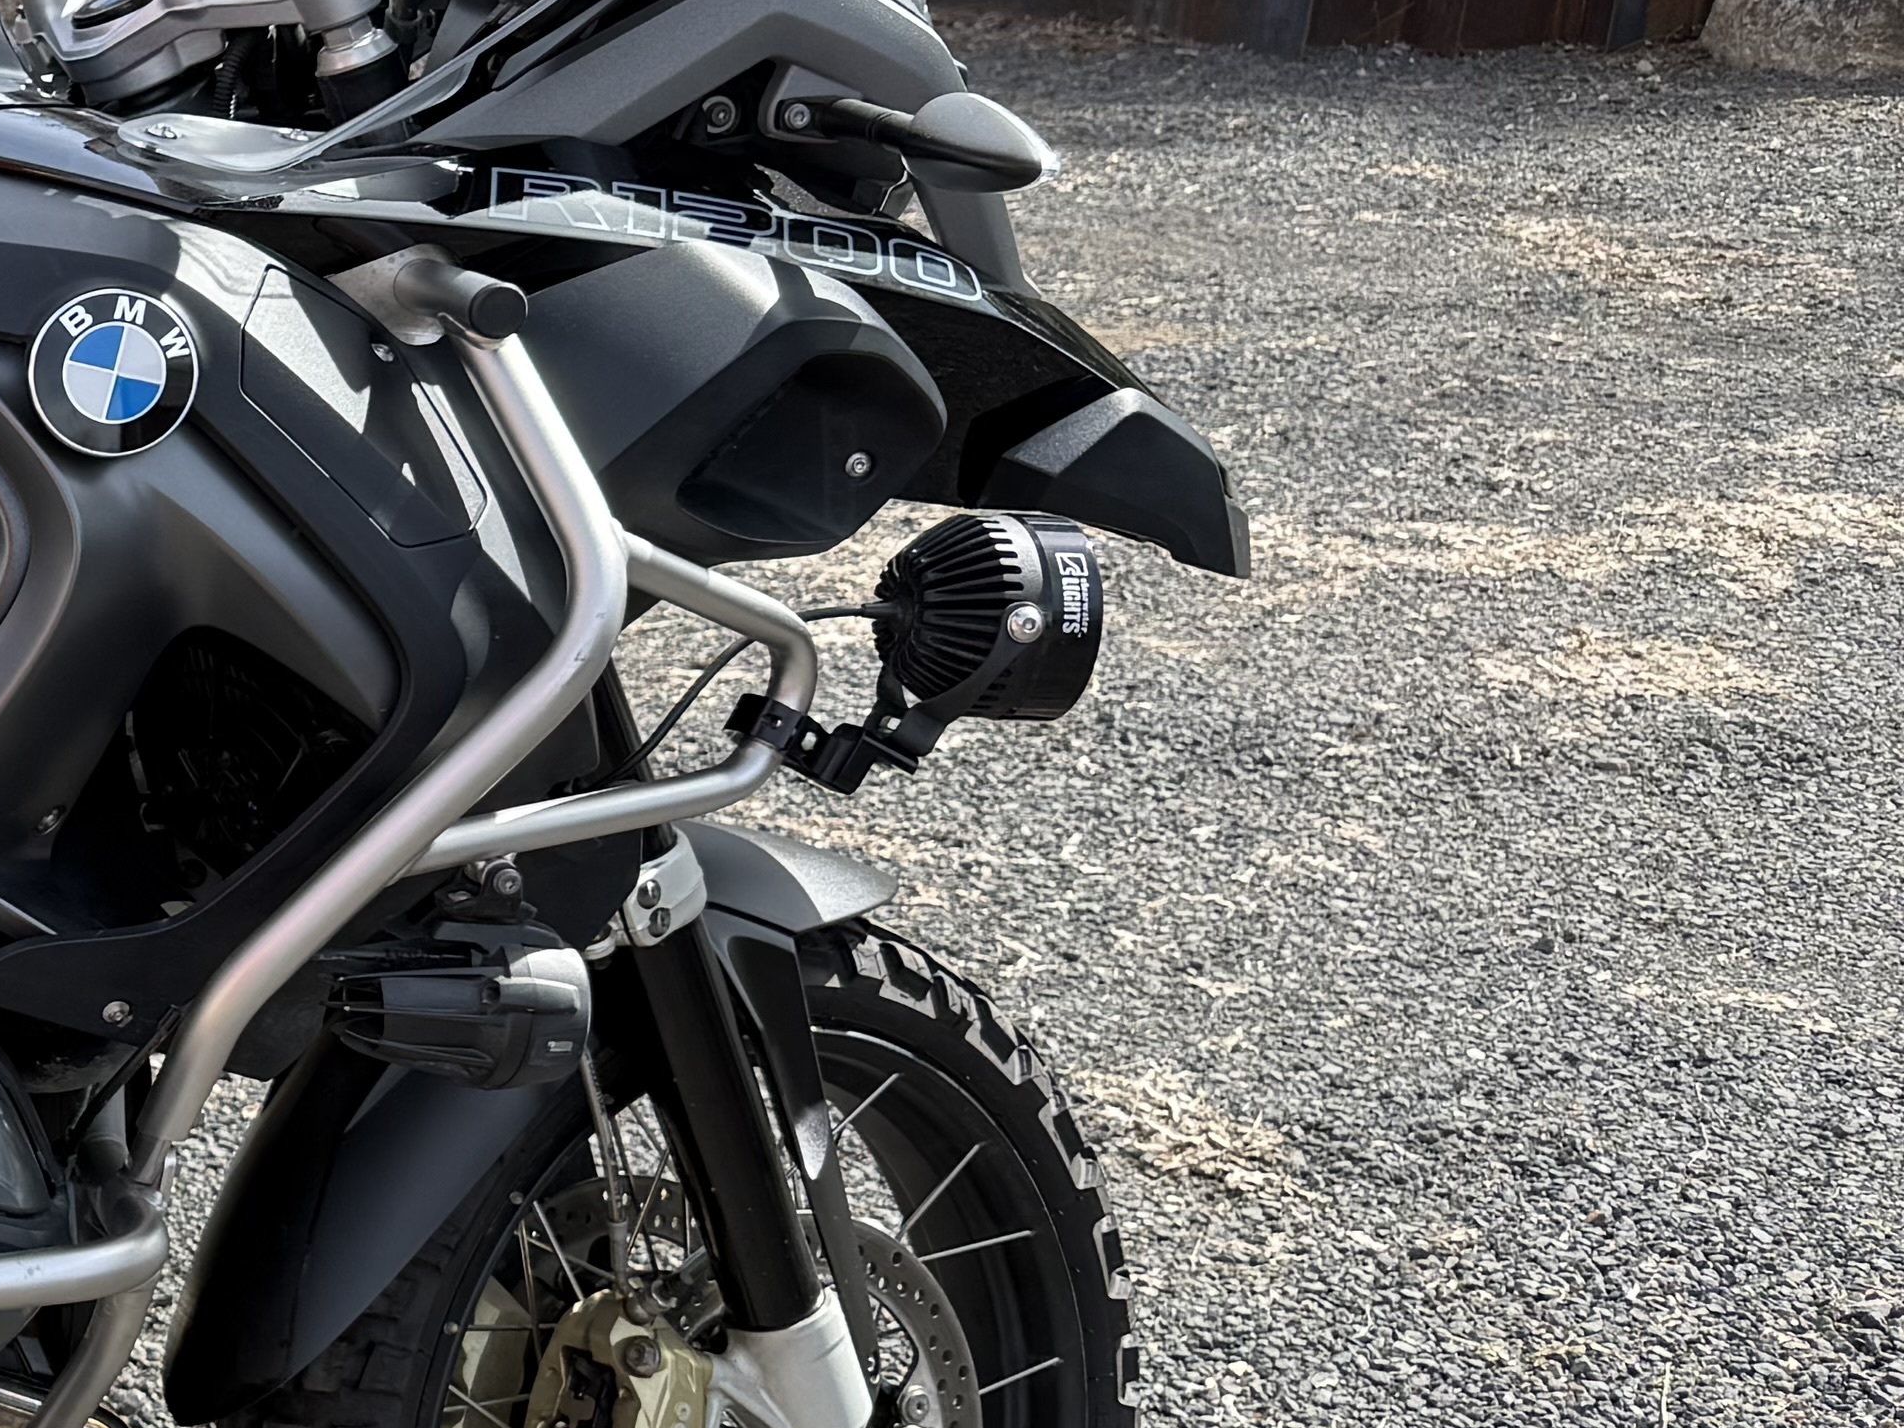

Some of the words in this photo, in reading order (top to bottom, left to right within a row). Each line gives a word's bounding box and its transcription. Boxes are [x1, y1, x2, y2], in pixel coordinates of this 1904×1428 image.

[488, 166, 983, 301] R1200
[58, 295, 190, 359] BMW
[1061, 576, 1082, 634] LIGHTS
